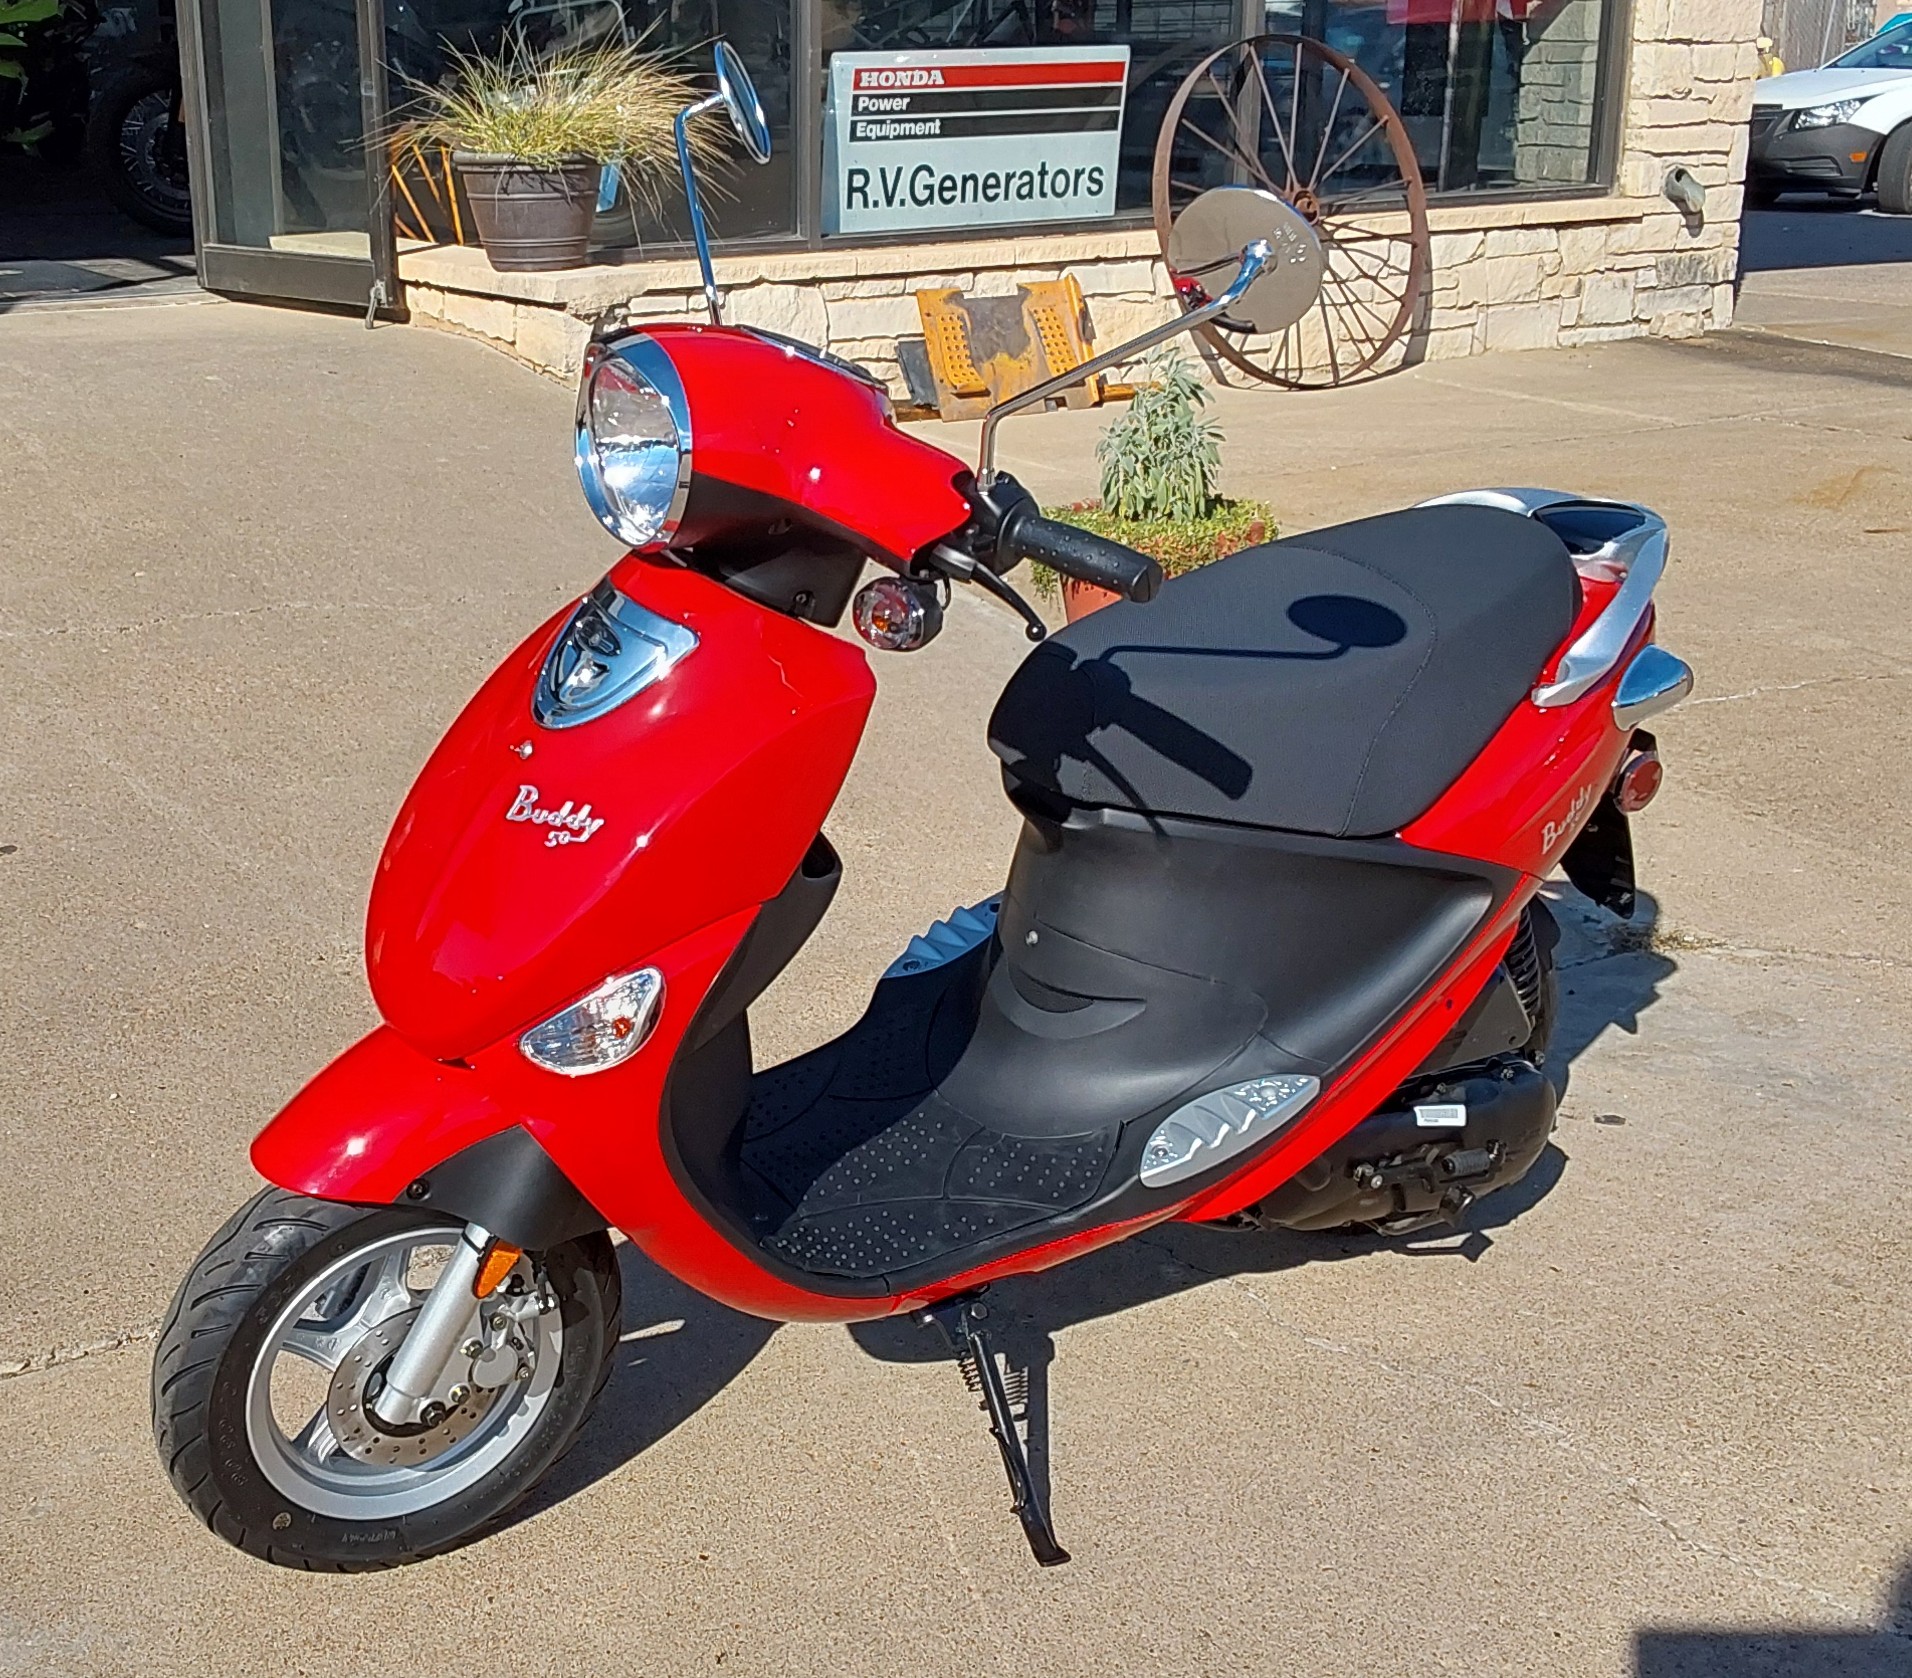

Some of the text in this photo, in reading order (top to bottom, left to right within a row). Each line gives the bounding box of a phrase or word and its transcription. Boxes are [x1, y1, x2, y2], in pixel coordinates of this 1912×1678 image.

[859, 69, 945, 88] HONDA
[857, 95, 911, 112] Power
[855, 118, 941, 140] Equipment
[506, 784, 604, 843] Buddy
[544, 830, 571, 848] 50
